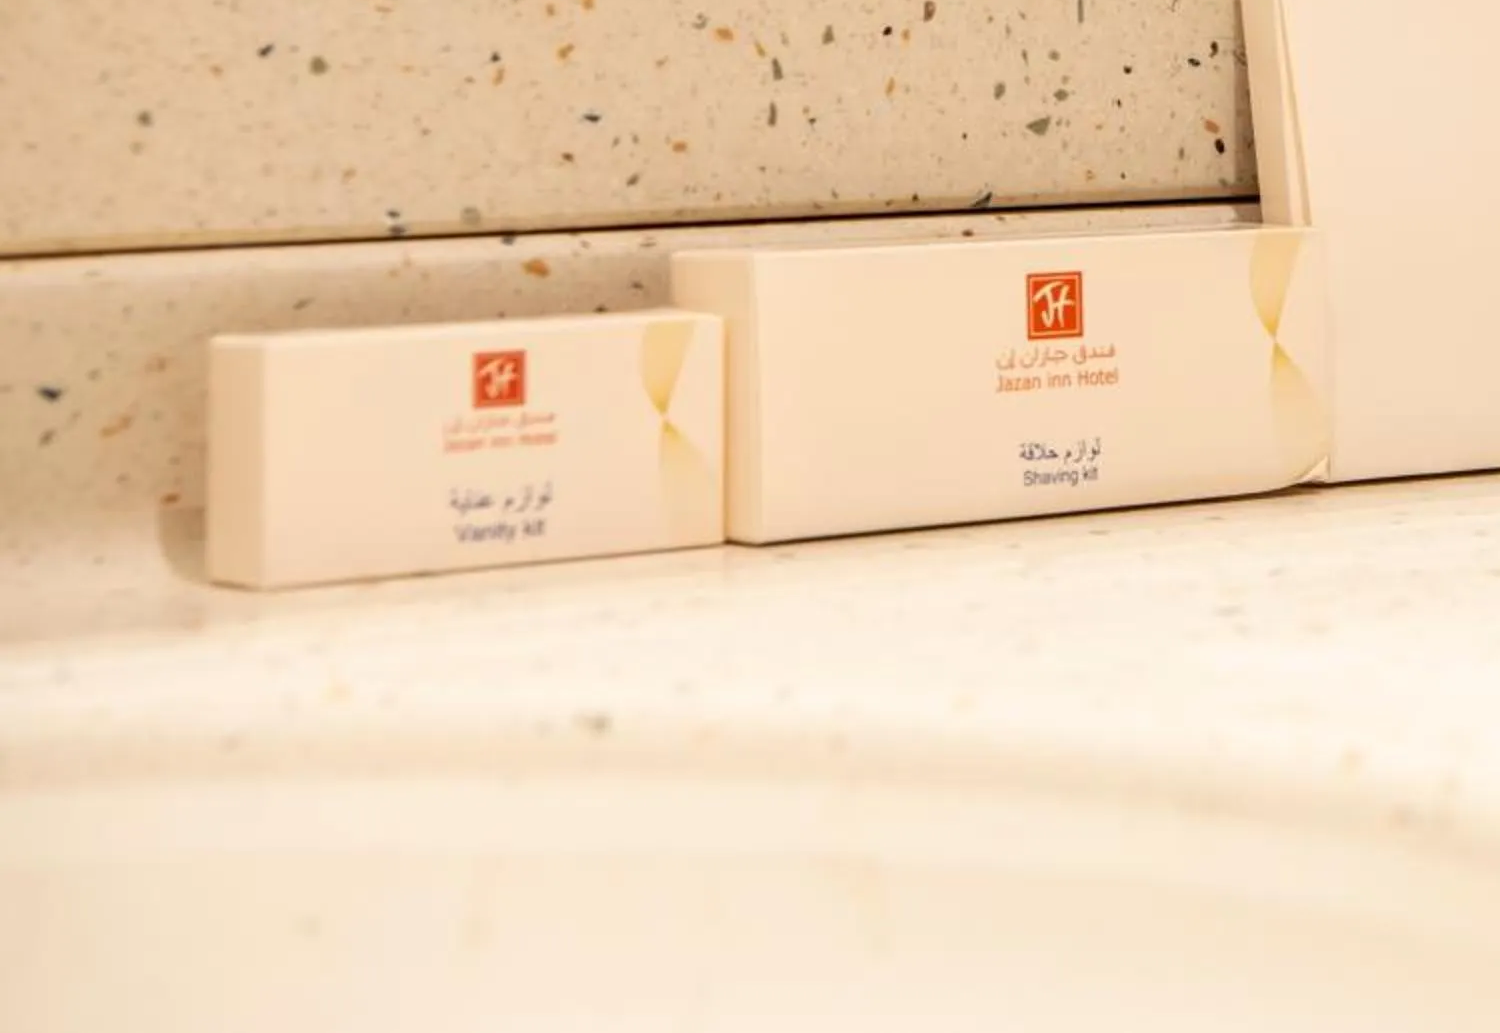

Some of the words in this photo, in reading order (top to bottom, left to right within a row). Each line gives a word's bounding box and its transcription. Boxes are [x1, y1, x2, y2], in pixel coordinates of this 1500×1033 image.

[1019, 345, 1069, 369] جازان
[1072, 343, 1116, 366] فندق
[996, 374, 1042, 395] Jazan
[1046, 372, 1073, 390] inn
[1077, 366, 1120, 387] Hotel
[1017, 441, 1059, 462] حلاقة
[1062, 437, 1103, 465] لوازم
[1023, 468, 1079, 488] Shaving
[1082, 466, 1099, 483] kit
